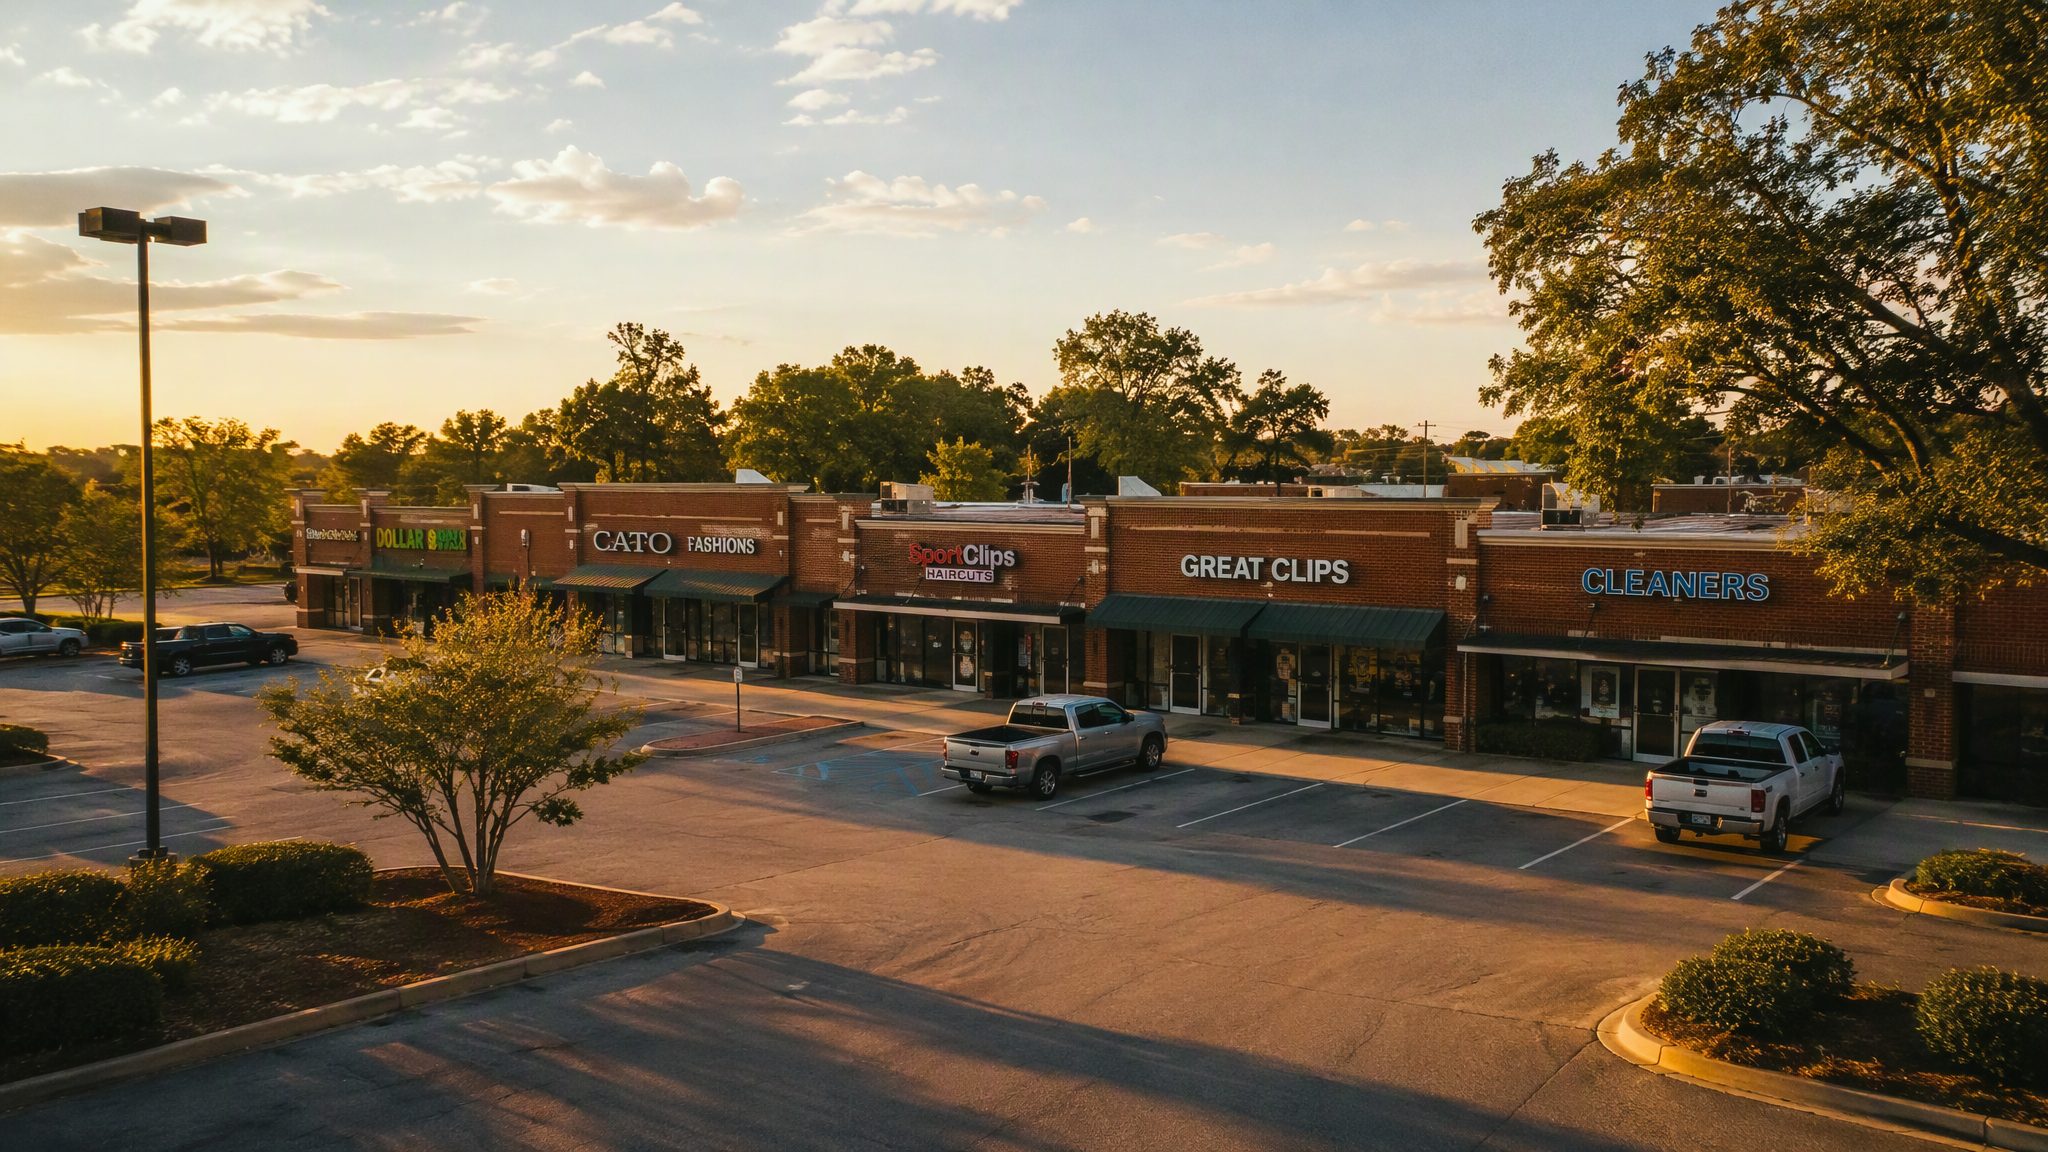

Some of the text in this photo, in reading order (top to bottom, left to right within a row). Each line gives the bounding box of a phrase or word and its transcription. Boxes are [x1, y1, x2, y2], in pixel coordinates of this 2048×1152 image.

[376, 527, 424, 549] DOLLAR
[593, 530, 755, 554] CATO FASHIONS
[927, 569, 993, 581] HAIRCUTS
[1180, 554, 1350, 584] GREAT CLIPS
[1581, 568, 1770, 601] CLEANERS
